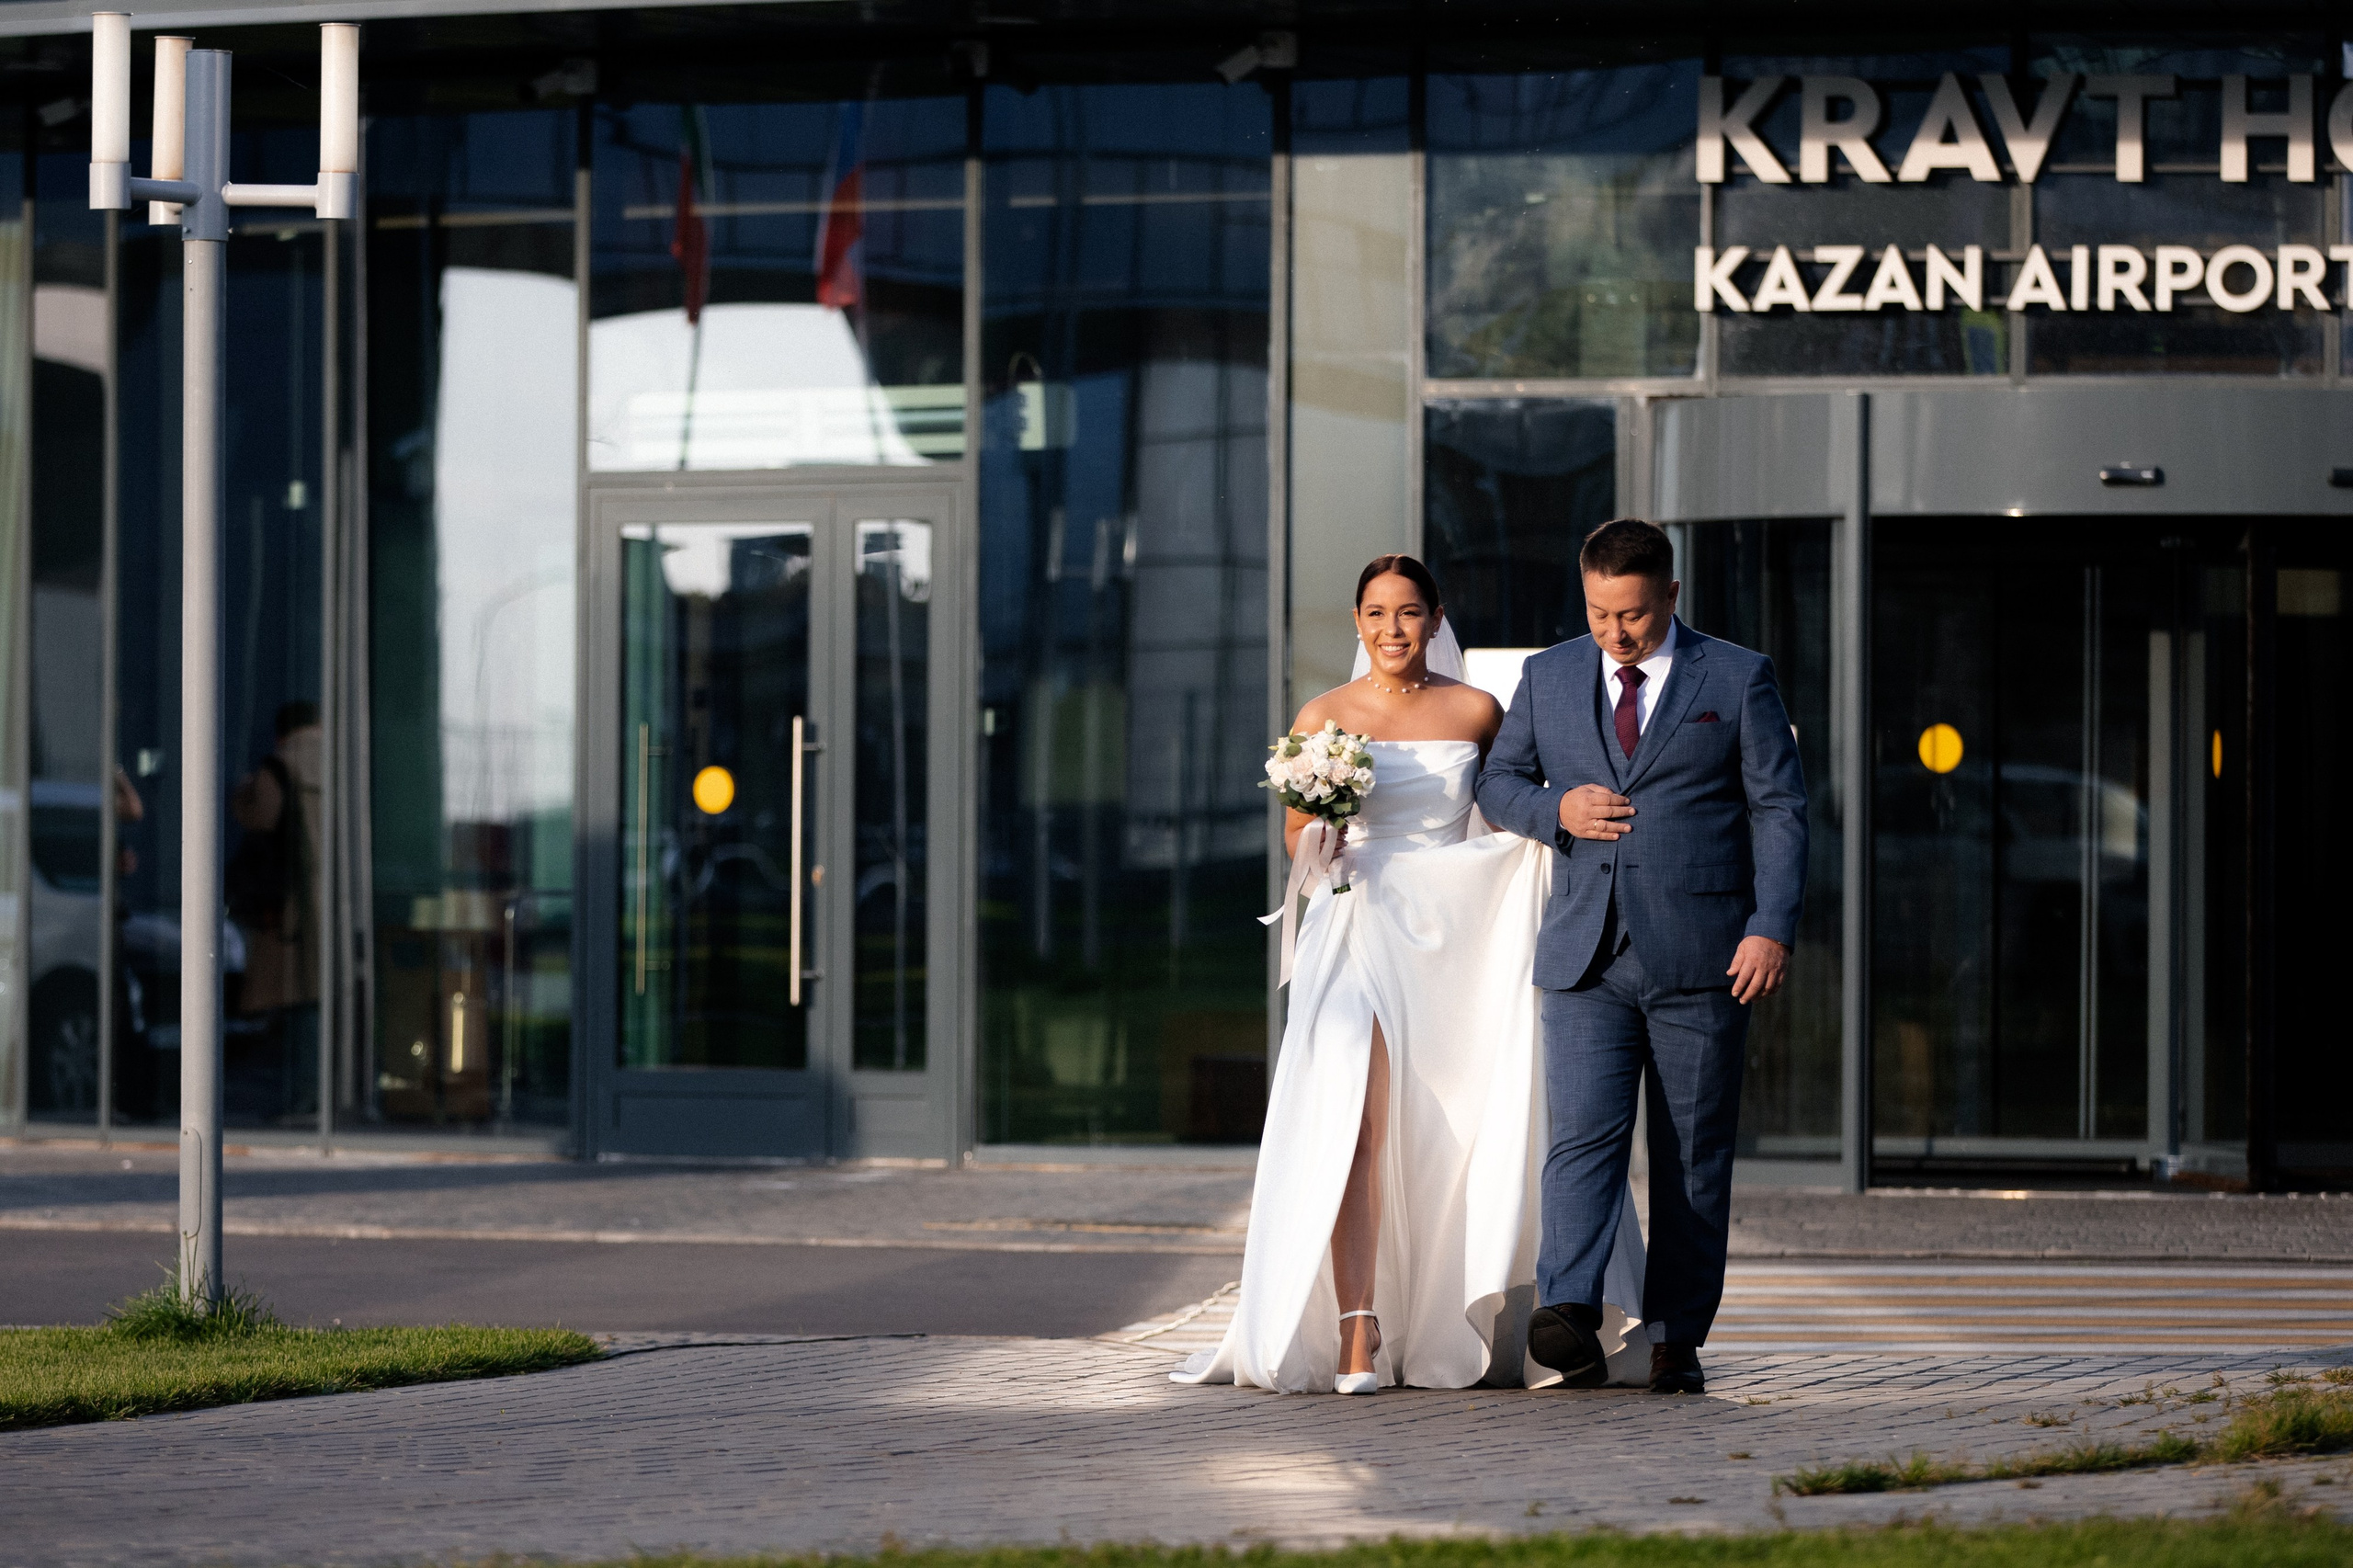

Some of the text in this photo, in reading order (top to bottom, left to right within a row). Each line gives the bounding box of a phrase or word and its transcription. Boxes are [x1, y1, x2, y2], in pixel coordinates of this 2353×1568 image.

[1696, 74, 2353, 183] KRAVT H
[1694, 244, 1984, 312] KAZAN
